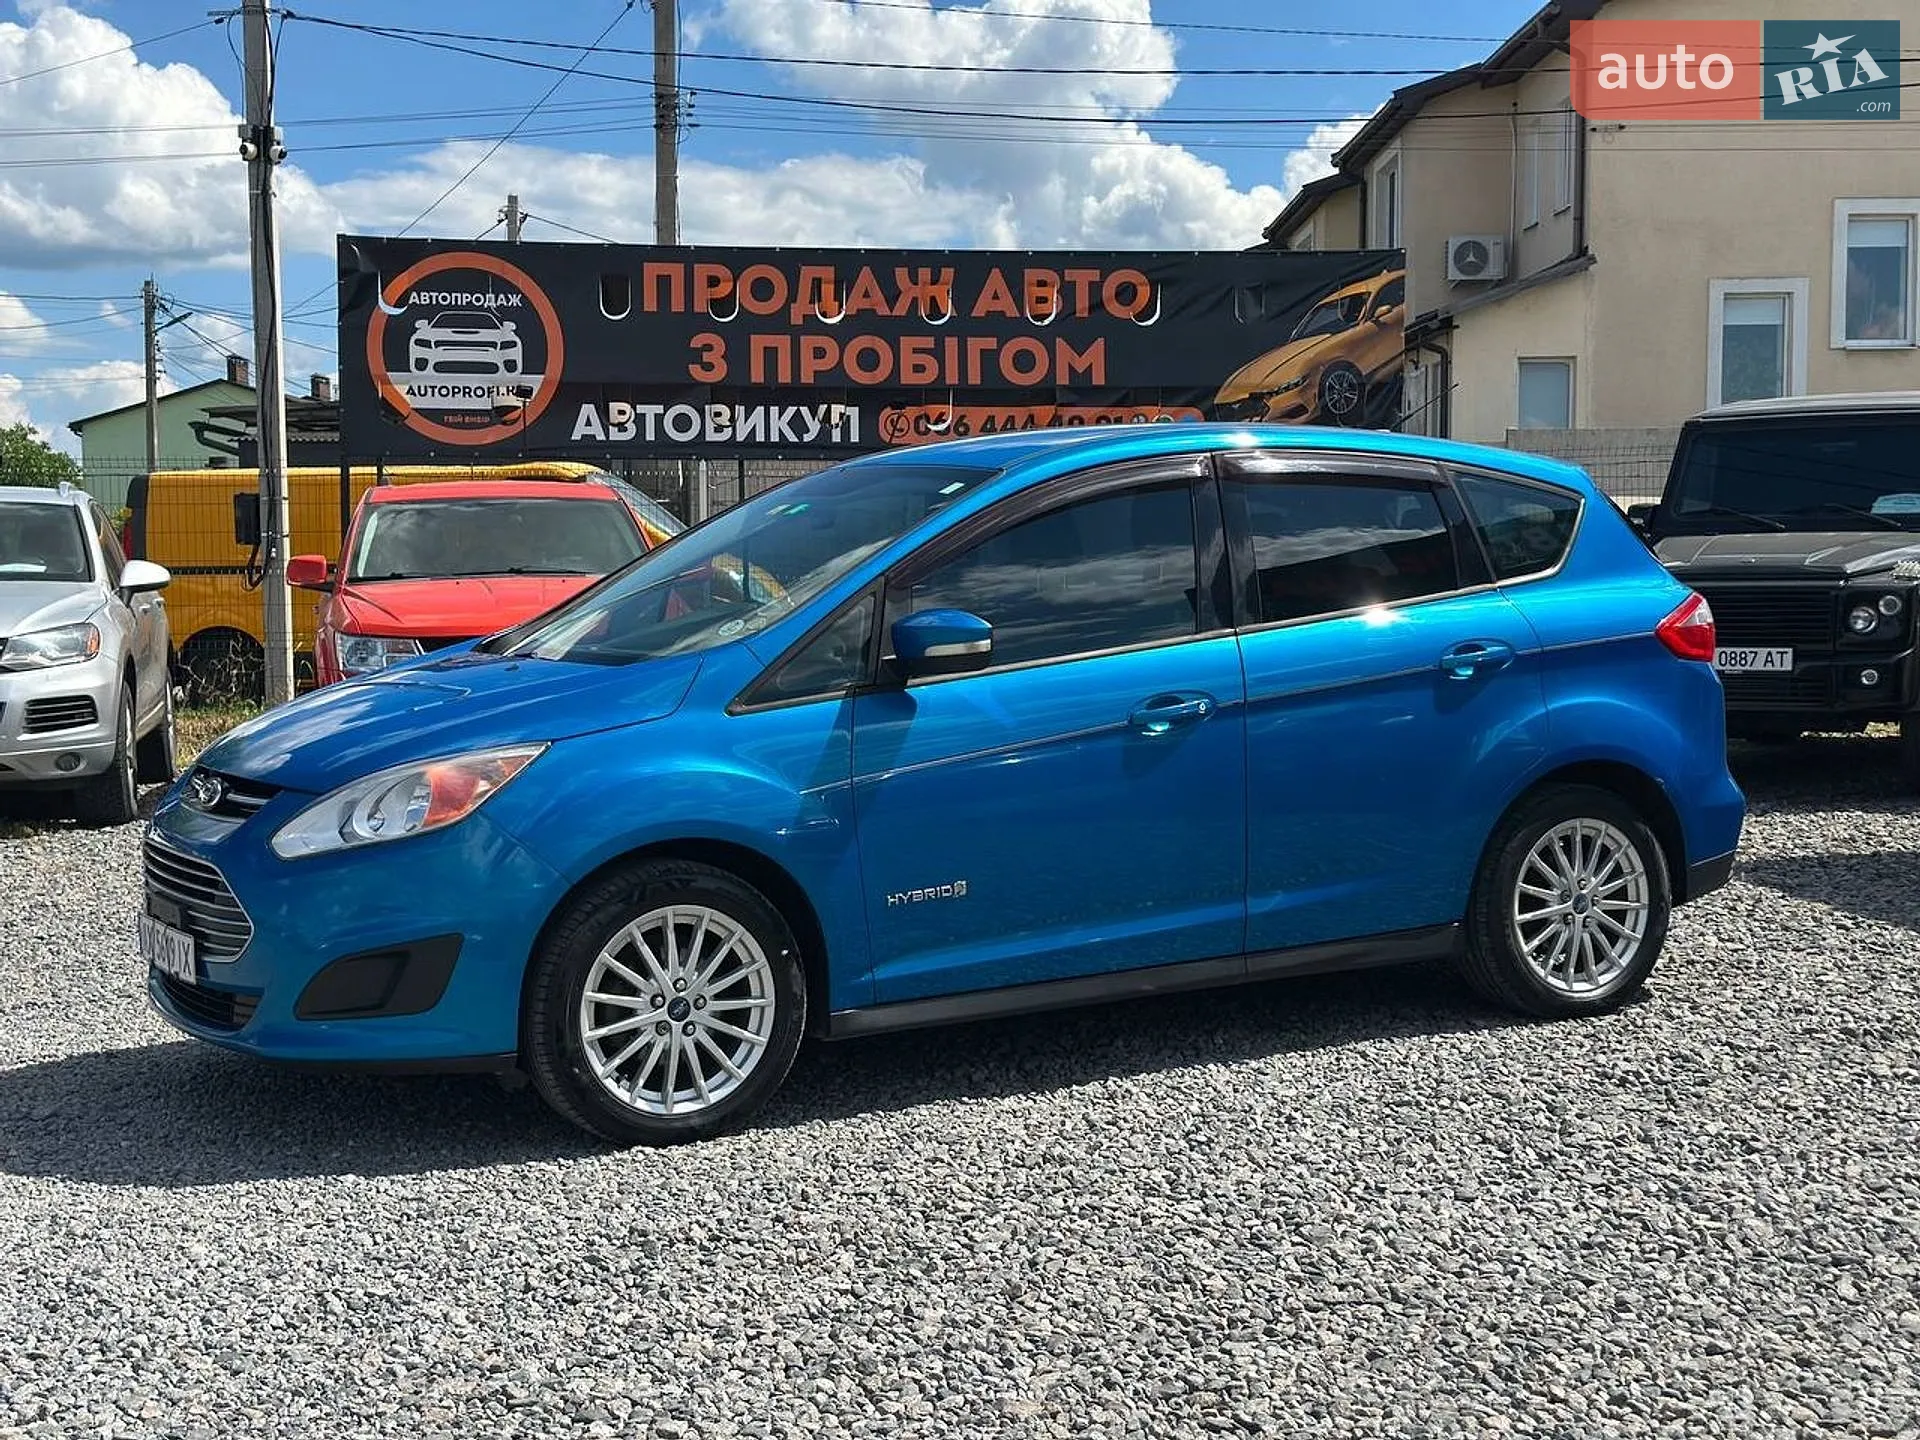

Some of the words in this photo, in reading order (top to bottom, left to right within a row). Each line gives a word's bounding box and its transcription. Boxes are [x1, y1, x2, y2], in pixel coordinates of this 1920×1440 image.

[408, 291, 522, 308] АВТОПРОДАЖ
[643, 262, 957, 324] ПРОДАЖ
[971, 267, 1151, 319] АВТО
[749, 334, 1106, 386] ПРОБІГОМ
[571, 402, 860, 442] АВТОВИКУП
[1719, 651, 1758, 667] 0887
[1764, 651, 1788, 667] AT
[887, 885, 953, 907] HYBRID
